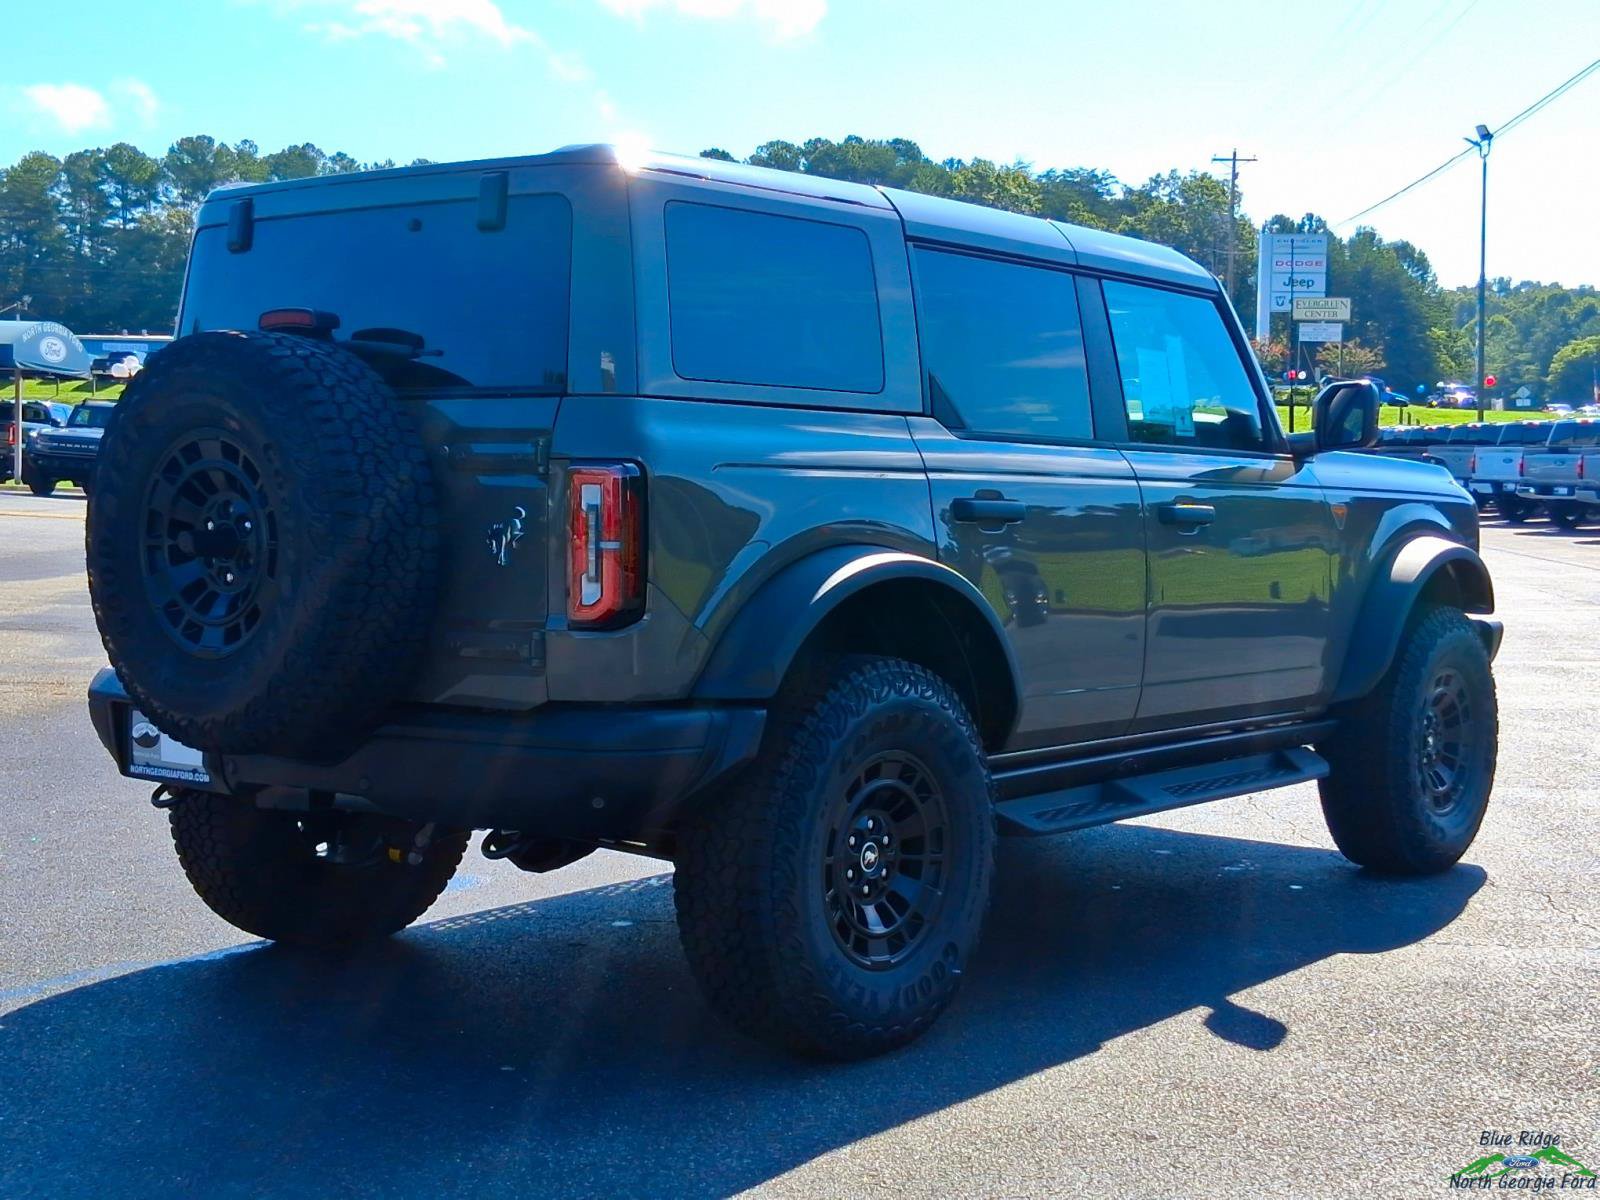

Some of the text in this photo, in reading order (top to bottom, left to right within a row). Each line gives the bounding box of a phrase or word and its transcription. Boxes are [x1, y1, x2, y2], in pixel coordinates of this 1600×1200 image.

[1283, 276, 1315, 290] Jeep
[1296, 299, 1348, 309] EVERGREEN
[1304, 310, 1338, 318] CENTER
[22, 324, 42, 342] NORTH
[43, 321, 69, 337] GEORGIA
[130, 764, 210, 783] NORTHGEORGIAFORD.COM
